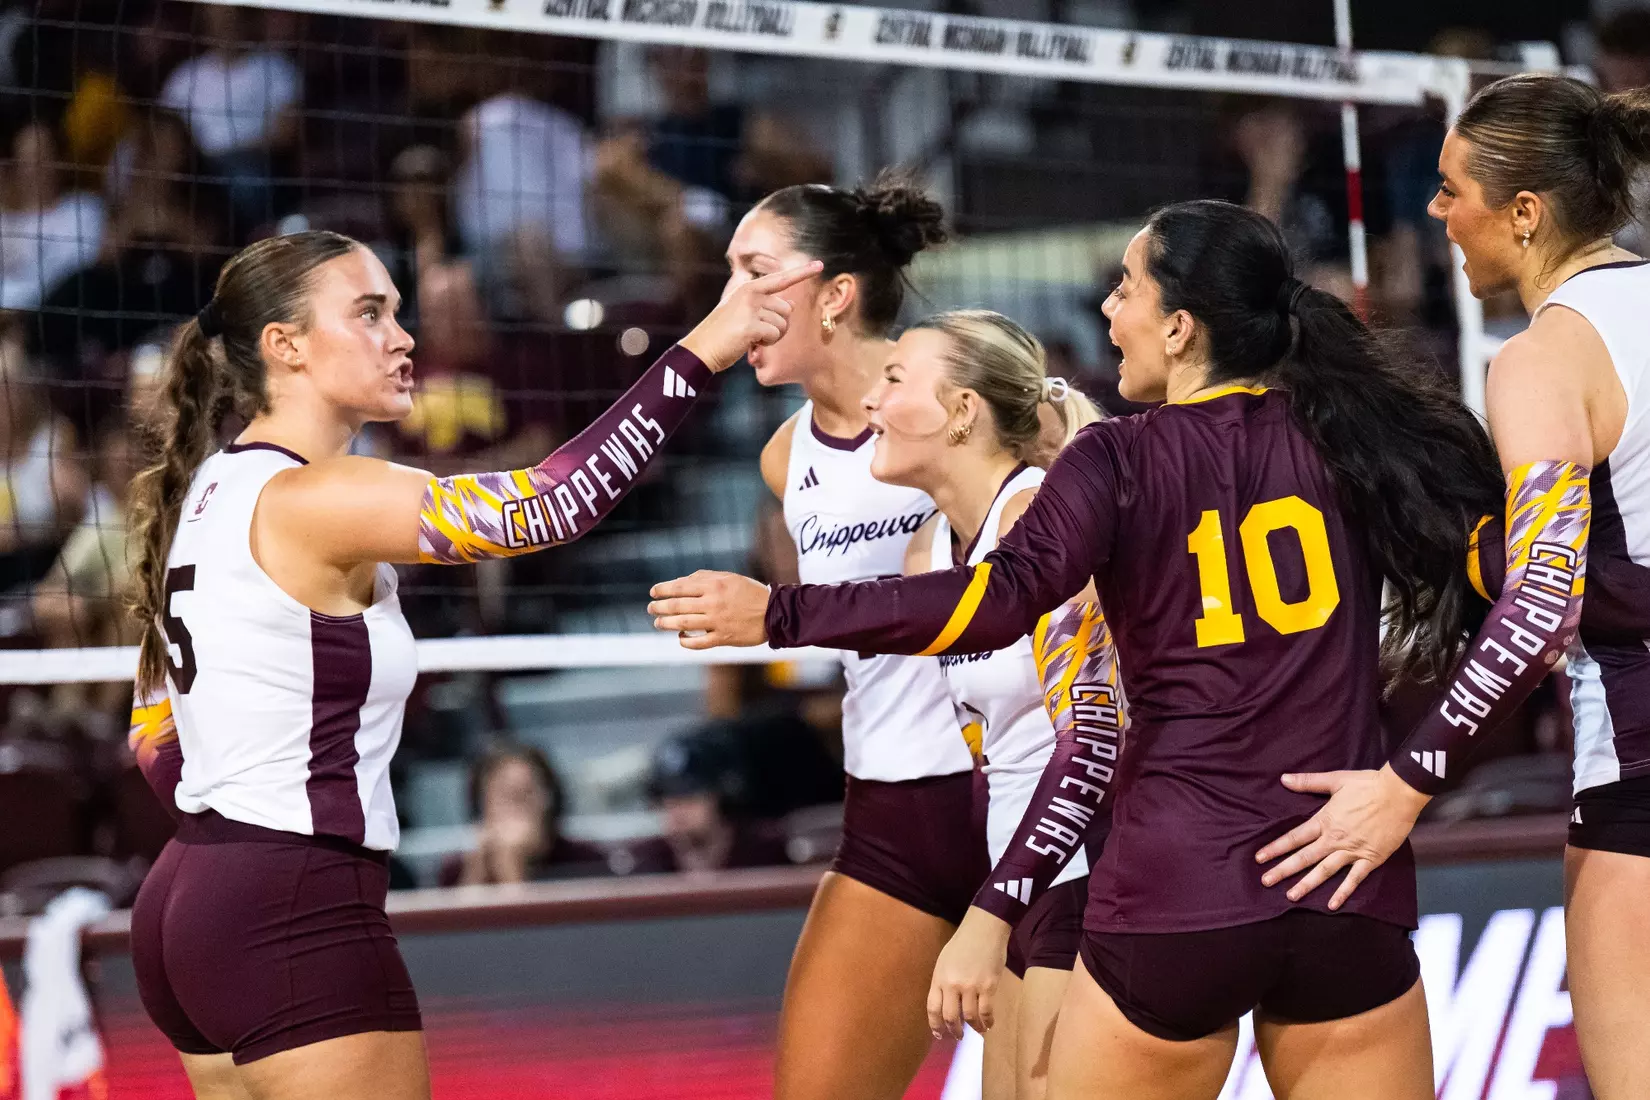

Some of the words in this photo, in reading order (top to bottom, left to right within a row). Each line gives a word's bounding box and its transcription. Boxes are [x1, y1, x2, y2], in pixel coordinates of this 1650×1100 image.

[502, 403, 666, 549] CHIPPEWAS
[800, 508, 940, 557] Chippewa
[164, 564, 198, 695] 5
[1187, 495, 1340, 648] 10
[1440, 541, 1577, 737] CHIPPEWAS
[1025, 684, 1118, 865] CHIPPEWAS
